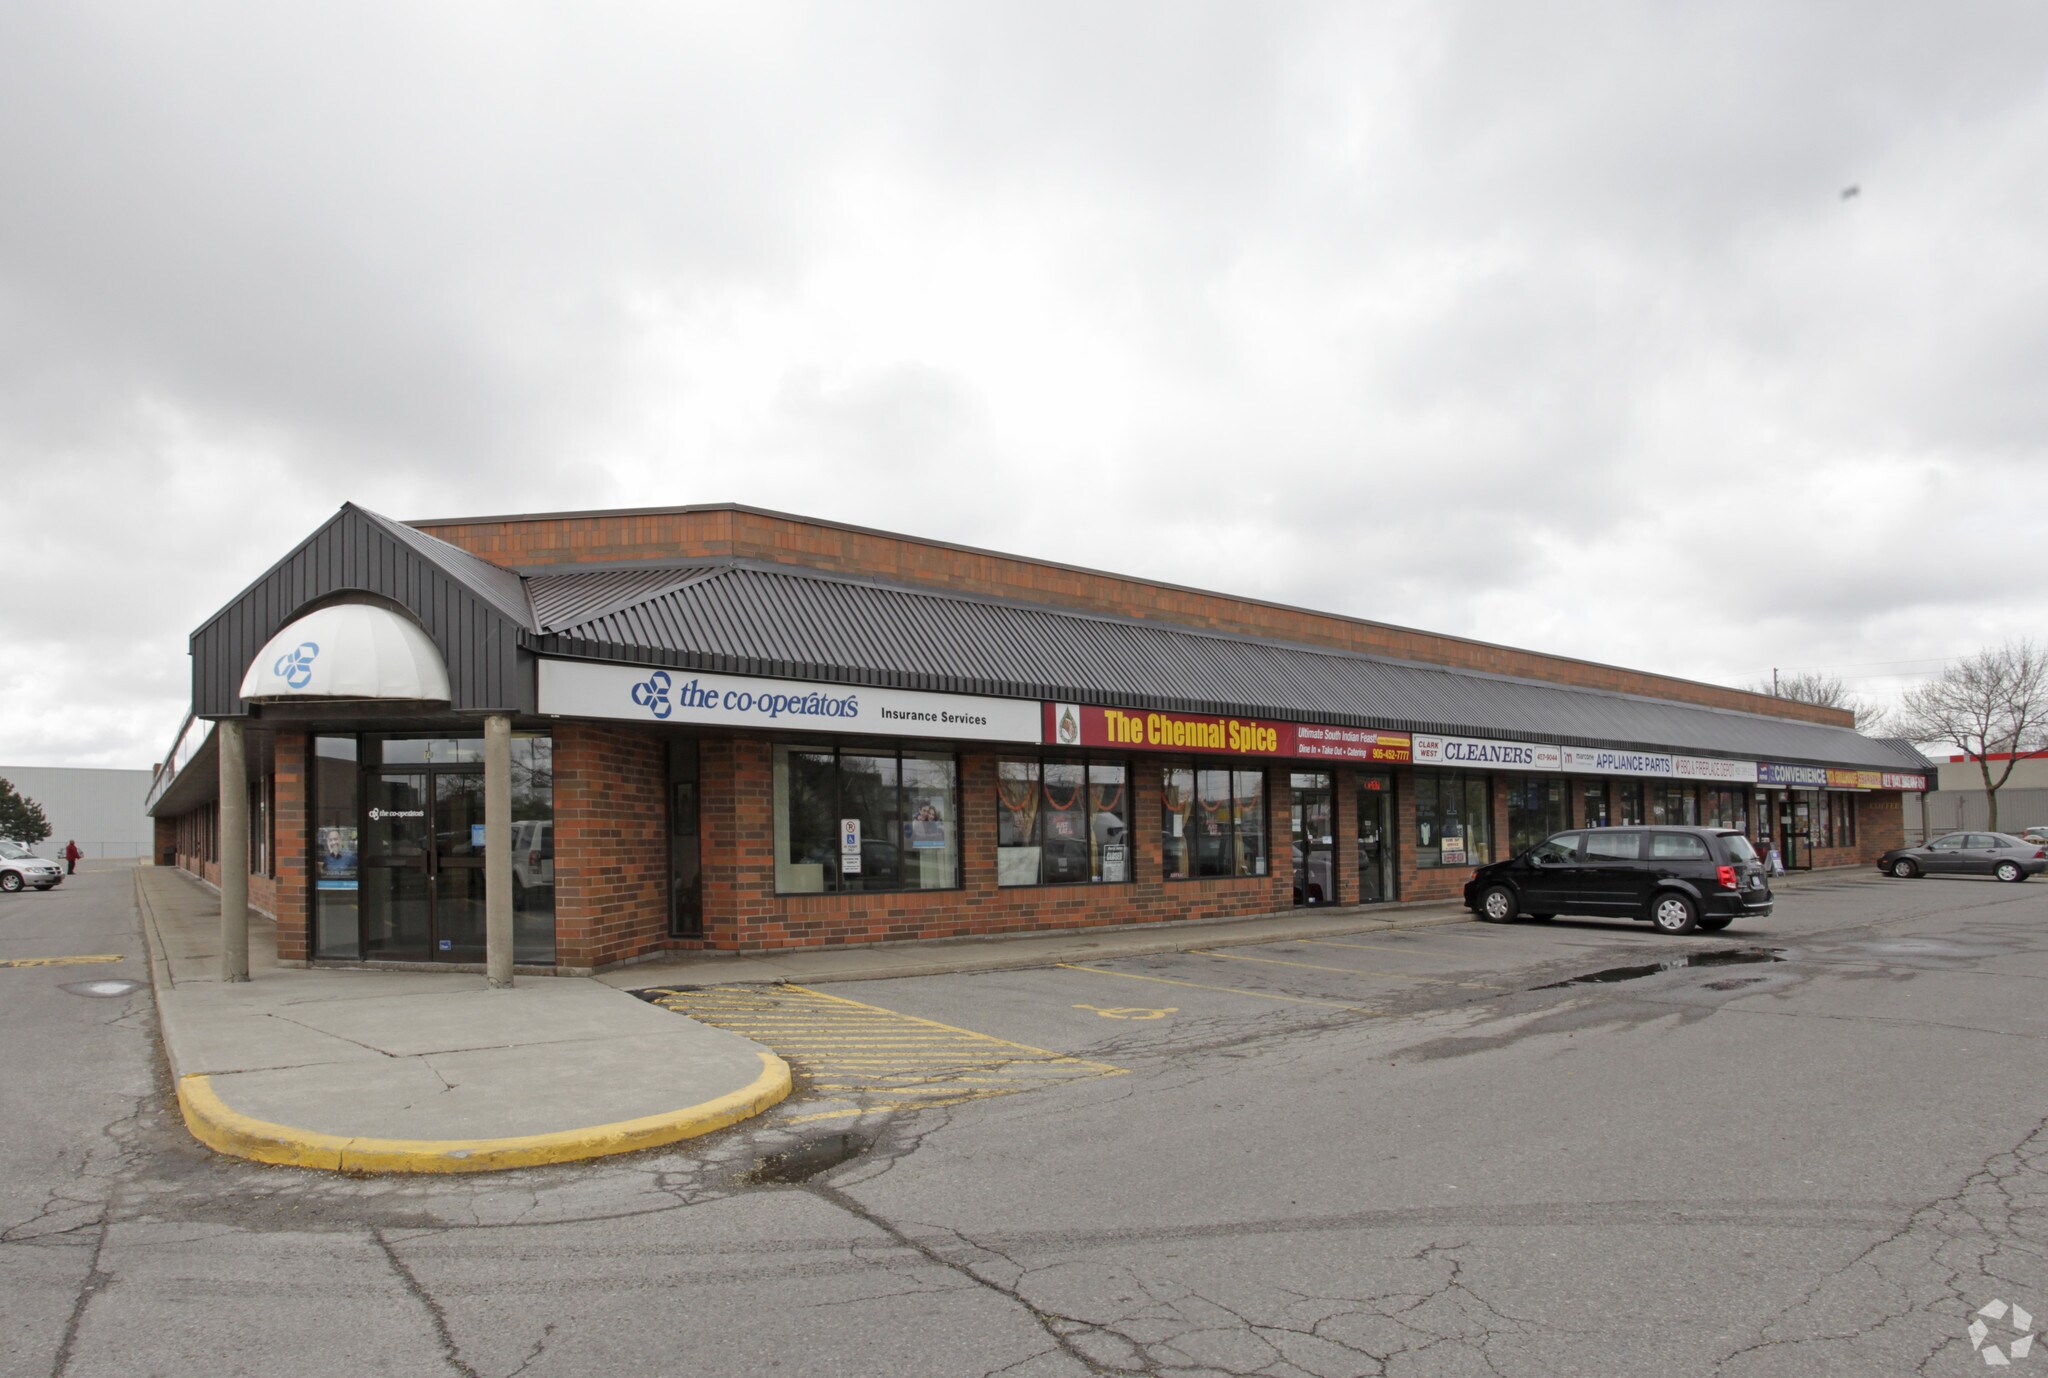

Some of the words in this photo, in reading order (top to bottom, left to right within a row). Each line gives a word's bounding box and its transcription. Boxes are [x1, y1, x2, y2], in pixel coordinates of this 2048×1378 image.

[680, 679, 719, 709] the
[723, 691, 858, 718] co-operators
[881, 707, 938, 724] Insurance
[941, 710, 987, 726] Services
[1104, 709, 1143, 744] The
[1147, 713, 1226, 749] Chennai
[1229, 719, 1277, 753] Spice
[1298, 727, 1323, 739] Ultimate
[1324, 729, 1341, 740] South
[1342, 731, 1359, 742] Indian
[1299, 744, 1311, 753] Dine
[1311, 745, 1317, 753] In
[1321, 746, 1333, 755] Take
[1334, 746, 1343, 755] Out
[1347, 747, 1367, 759] Catering
[1372, 748, 1409, 760] 905-452-7777
[1418, 741, 1439, 749] CLARK
[1420, 750, 1438, 758] WEST
[1445, 742, 1533, 764] CLEANERS
[1596, 753, 1643, 771] APPLIANCE
[1645, 757, 1670, 773] PARTS
[1774, 765, 1827, 784] CONVENIENCE
